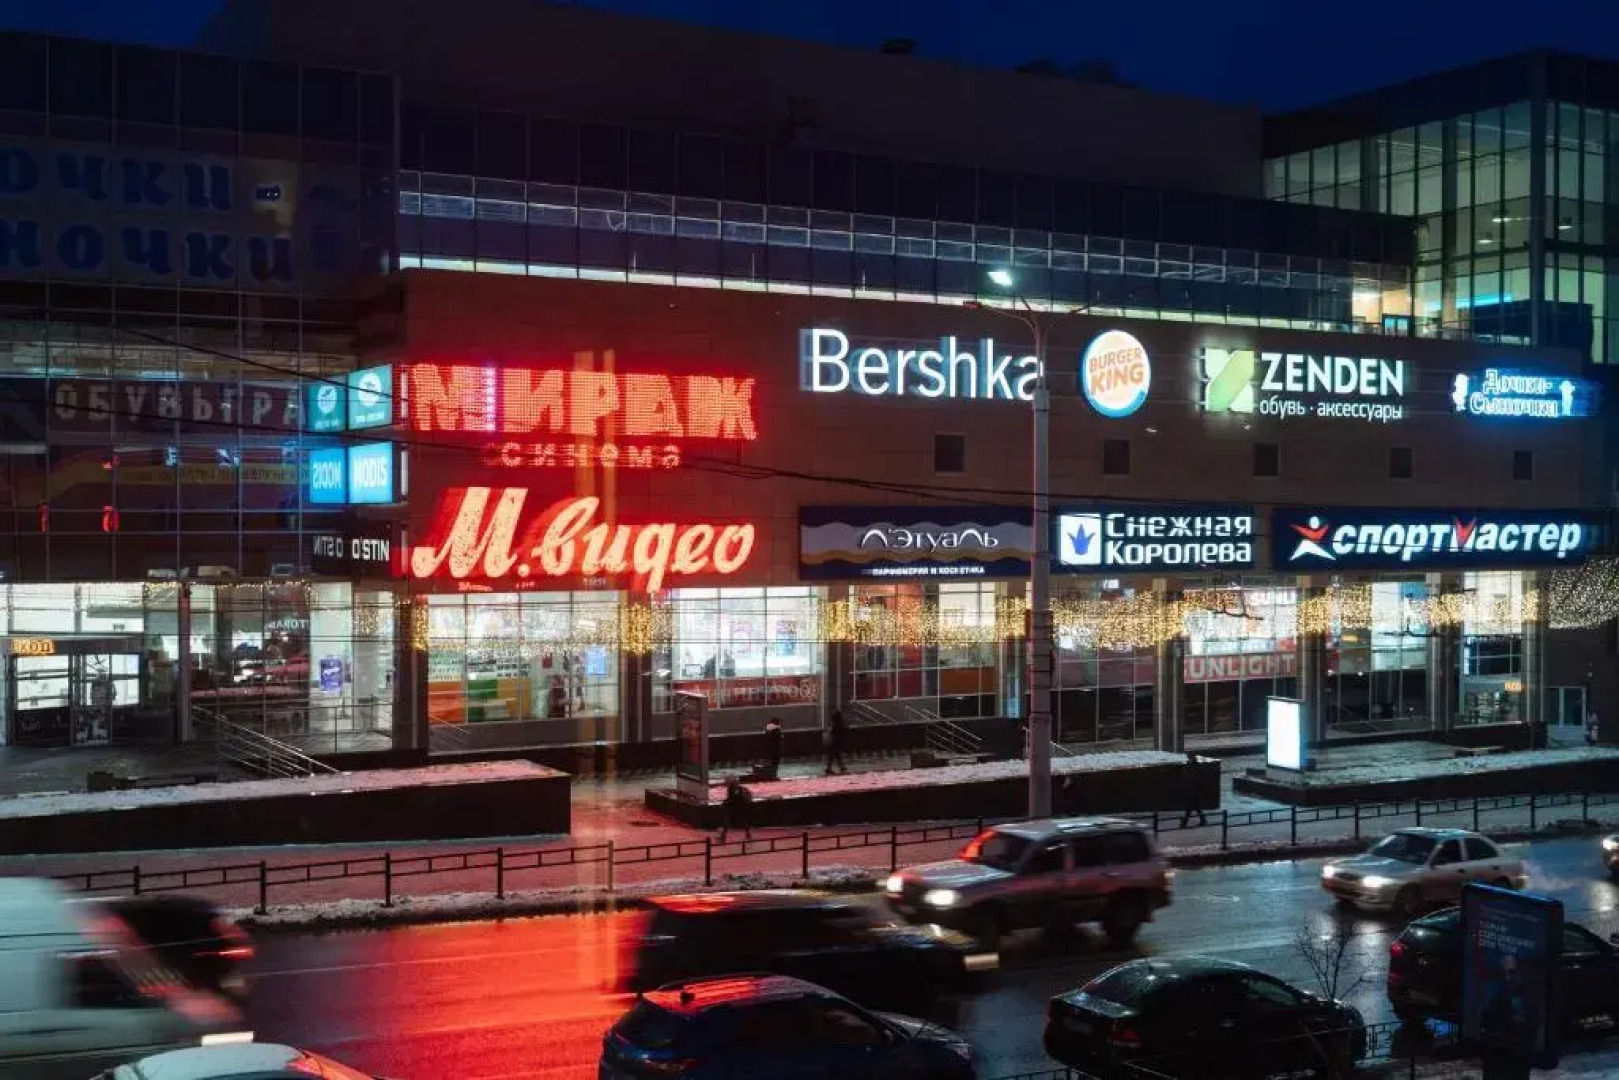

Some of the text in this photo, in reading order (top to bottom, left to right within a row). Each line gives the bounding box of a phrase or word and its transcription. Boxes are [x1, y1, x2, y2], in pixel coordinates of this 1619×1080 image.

[811, 328, 1044, 401] Bershka
[1089, 347, 1142, 373] BURGER
[1260, 352, 1405, 397] ZENDEN
[1090, 362, 1145, 394] KING
[411, 363, 757, 441] МИРАЖ
[1259, 399, 1403, 424] обувь аксессуары
[410, 486, 755, 594] М.видео
[1105, 511, 1252, 540] Снежная
[1105, 538, 1252, 565] Королева
[1186, 653, 1296, 679] UNLIGHT
